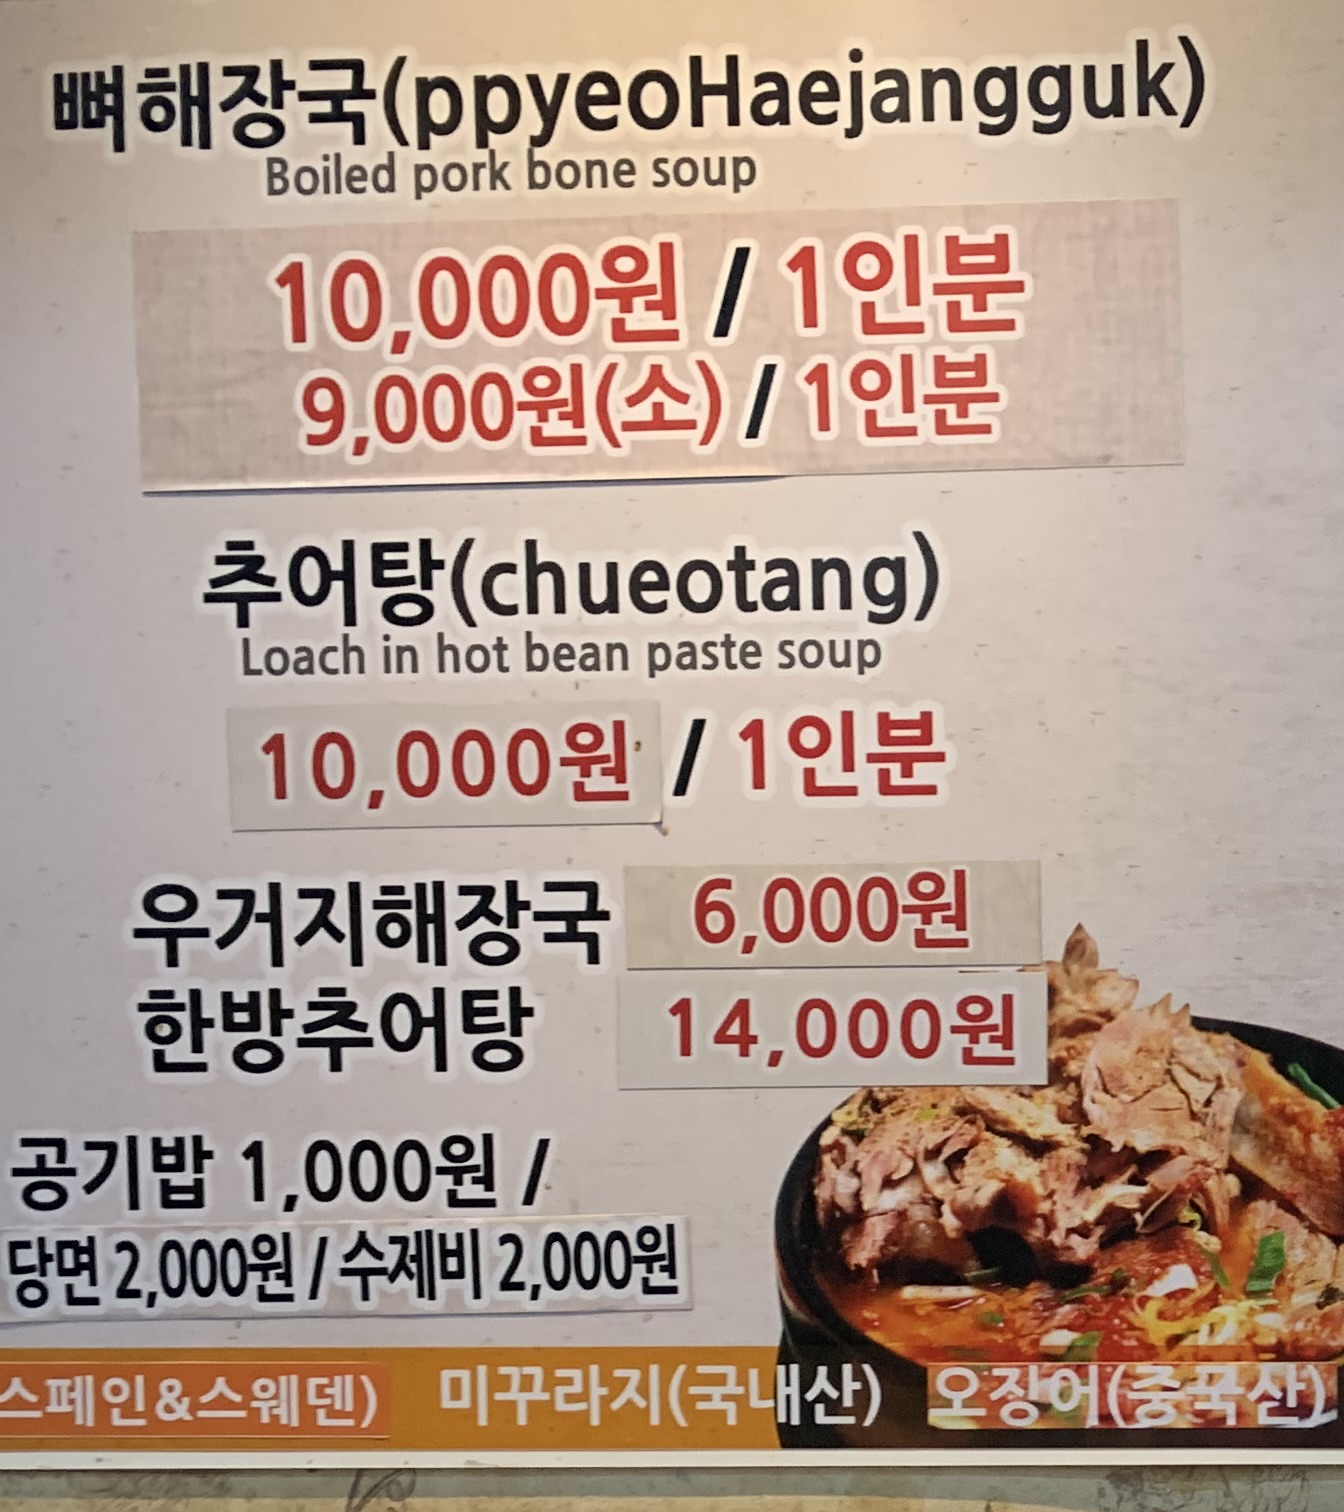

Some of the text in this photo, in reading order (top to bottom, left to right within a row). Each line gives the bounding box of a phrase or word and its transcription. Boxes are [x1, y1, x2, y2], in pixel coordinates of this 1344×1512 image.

[51, 35, 1205, 153] 뼈해장국(ppyeoHaejangguk)
[265, 147, 758, 197] Boiled pork bone soup
[271, 240, 681, 356] 10,000원
[785, 231, 1027, 338] 1인분
[300, 356, 721, 458] 9,000원(소)
[803, 353, 1003, 439] 1인분
[201, 529, 939, 630] 추어탕(chueotang)
[241, 630, 882, 680] Loach in hot bean paste soup
[259, 718, 631, 810] 10,000원
[737, 707, 948, 797] 1인분
[132, 868, 972, 969] 우거지해장국 6,000원
[137, 985, 1018, 1075] 한방추어탕 14,000원
[10, 1133, 213, 1212] 공기밥
[241, 1132, 497, 1213] 1,000원
[8, 1234, 101, 1309] 당면
[114, 1231, 296, 1308] 2,000원
[338, 1227, 482, 1301] 수제비
[498, 1223, 680, 1301] 2,000원
[440, 1363, 882, 1430] 미꾸라지(국내산)
[931, 1363, 1327, 1430] 오징어(중국산)
